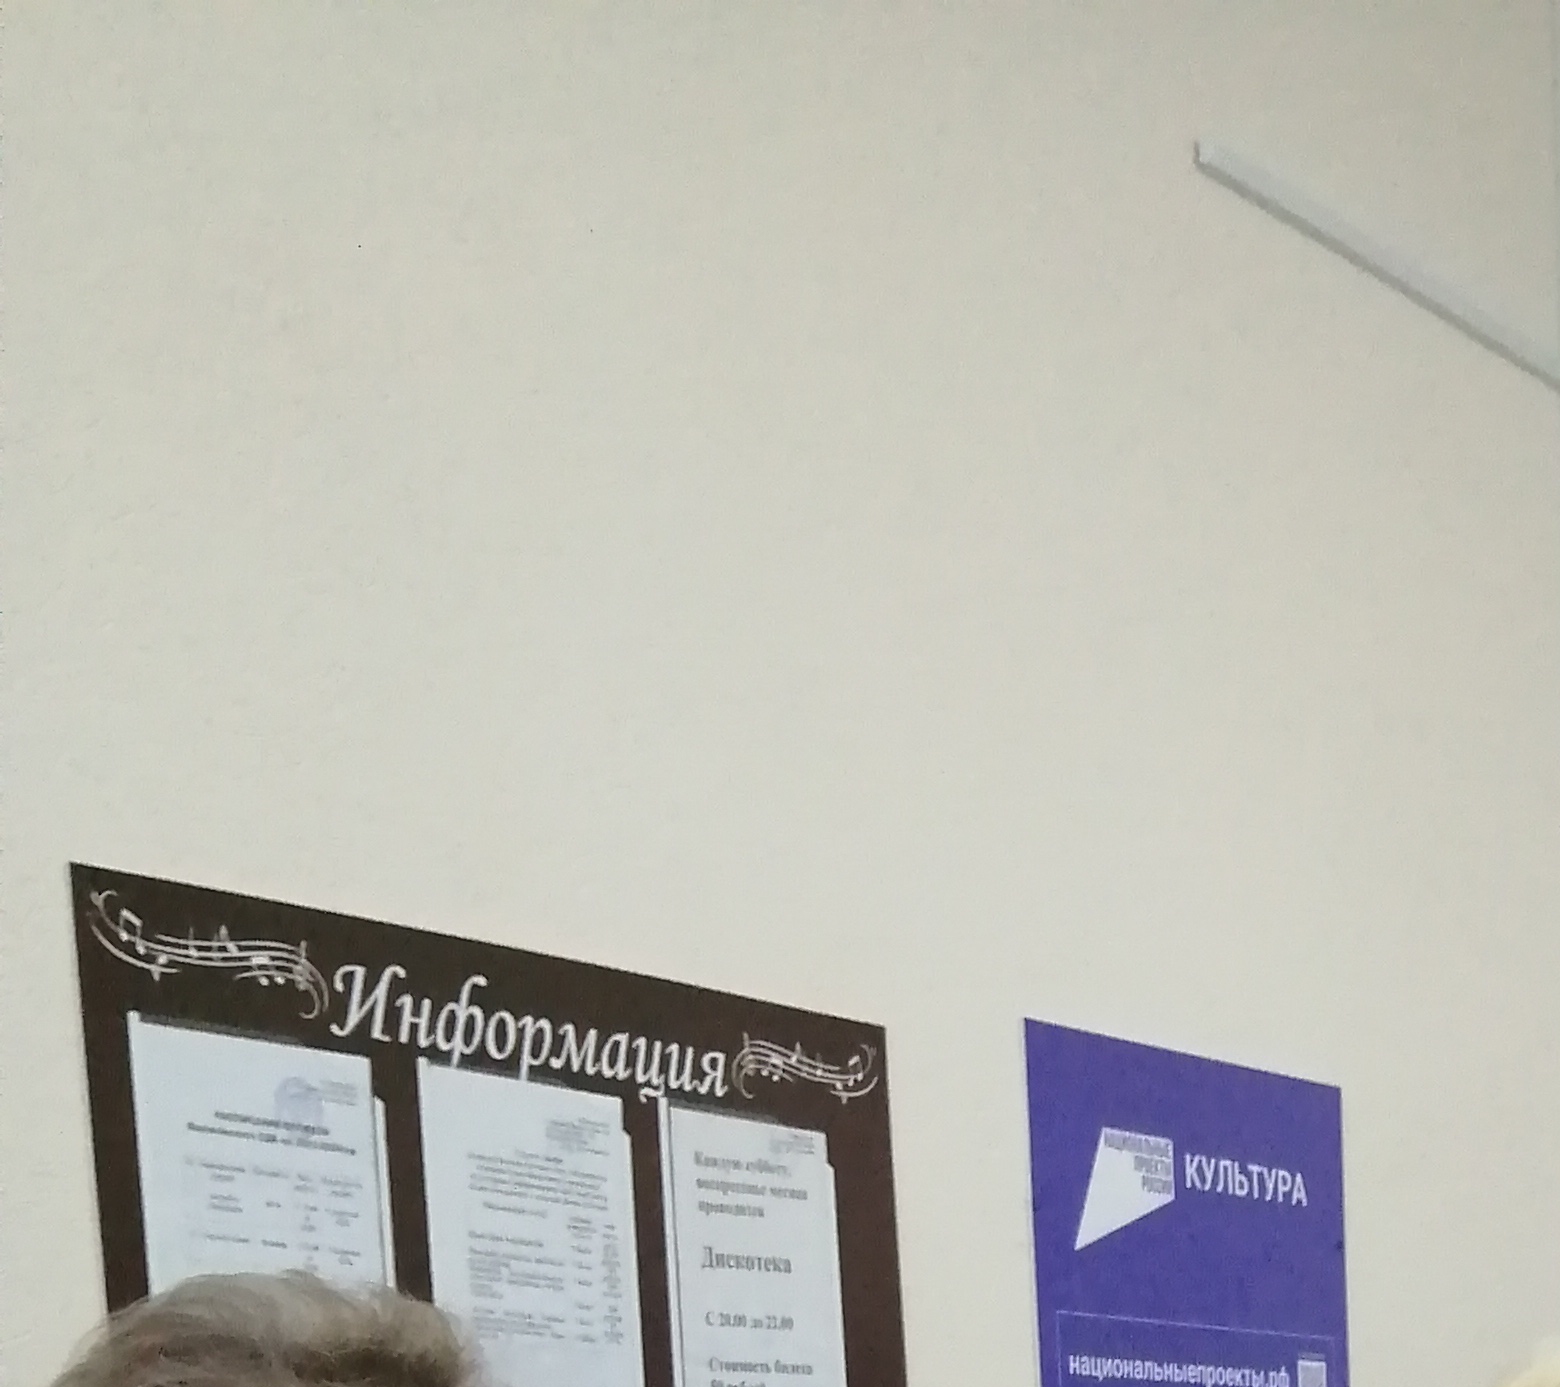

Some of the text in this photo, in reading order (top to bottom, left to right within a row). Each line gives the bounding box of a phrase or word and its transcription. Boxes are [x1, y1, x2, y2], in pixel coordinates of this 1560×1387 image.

[330, 963, 729, 1105] Информация
[1184, 1152, 1308, 1207] КУЛЬТУРА
[701, 1246, 793, 1274] Дискотека
